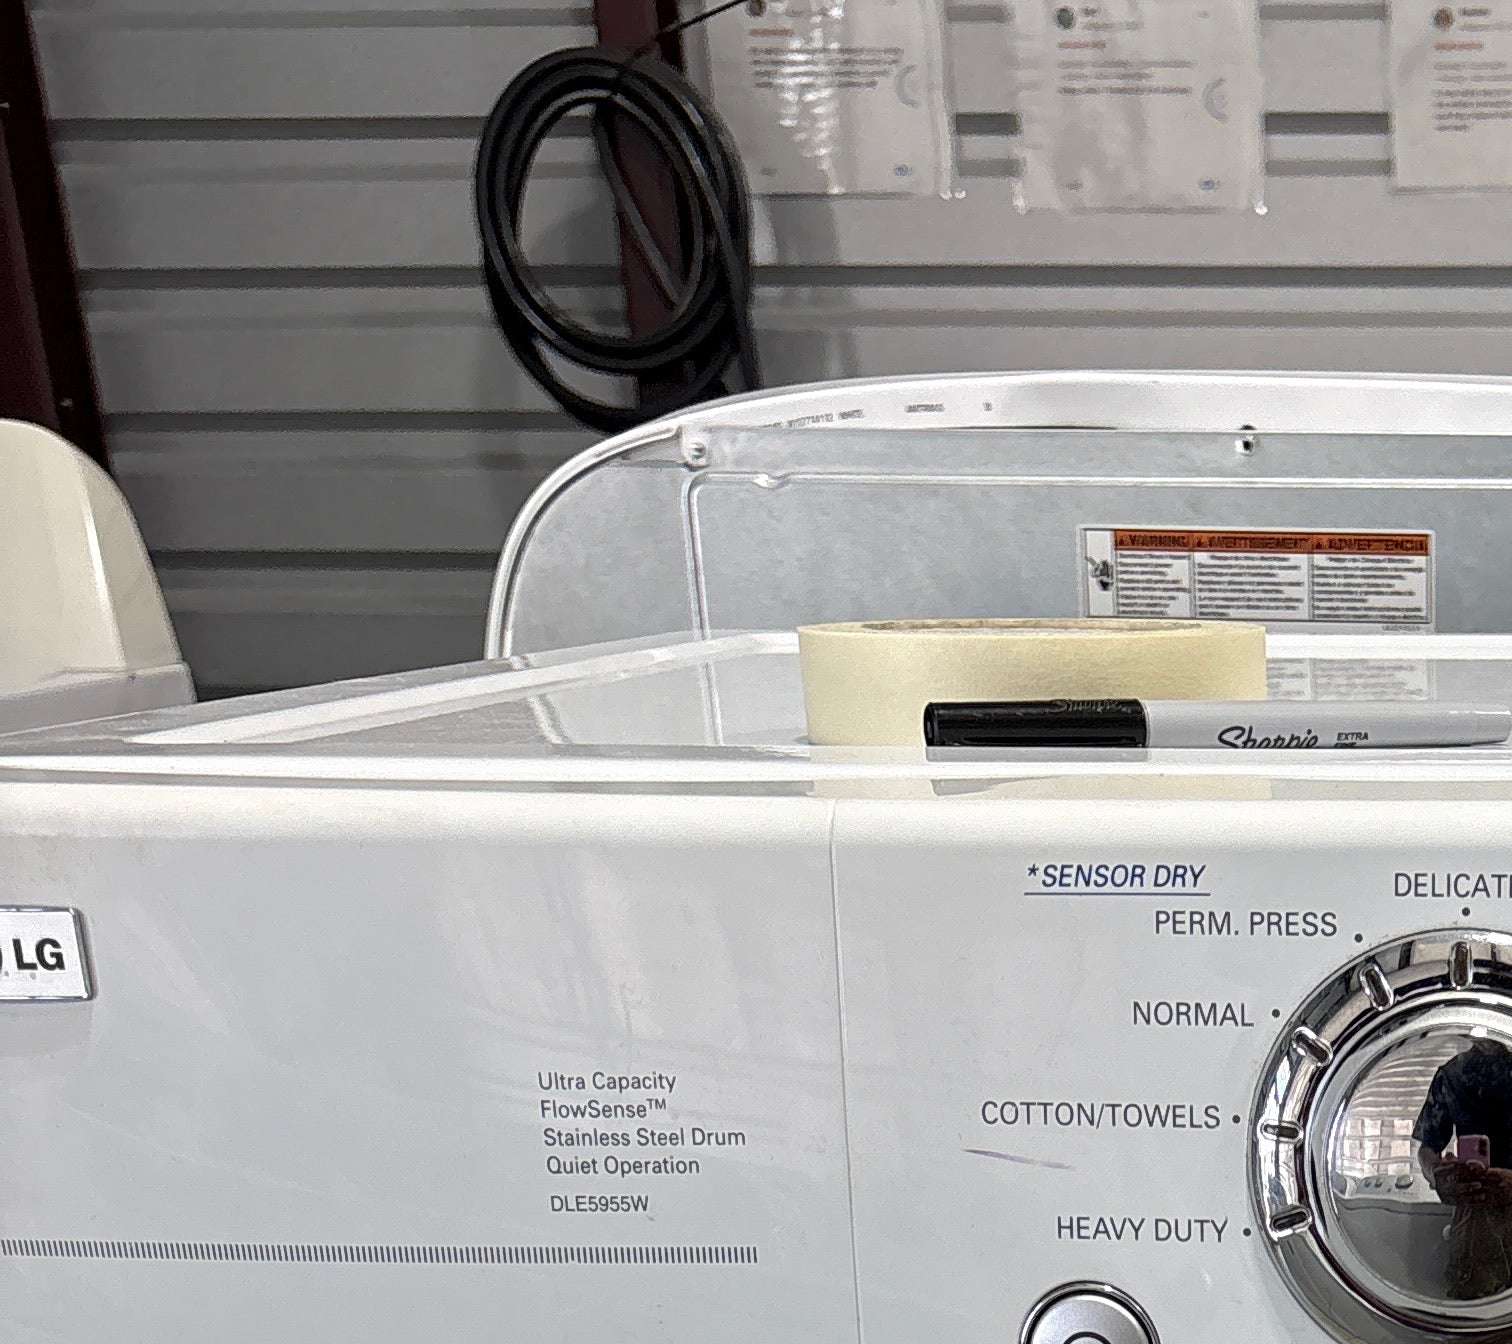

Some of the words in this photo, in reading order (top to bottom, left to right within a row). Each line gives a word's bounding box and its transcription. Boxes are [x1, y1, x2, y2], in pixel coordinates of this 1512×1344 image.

[1336, 732, 1369, 741] EXTRA
[1154, 865, 1206, 888] DRY
[1156, 911, 1239, 935] PERM.
[1250, 912, 1337, 936] PRESS
[12, 938, 65, 971] LG
[1134, 1001, 1254, 1027] NORMAL
[538, 1072, 585, 1090] Ultra
[593, 1072, 676, 1093] Capacity
[982, 1101, 1220, 1129] COTTON/TOWELS
[544, 1128, 630, 1146] Stainless
[637, 1128, 684, 1146] Steel
[692, 1128, 745, 1145] Drum
[547, 1156, 598, 1174] Quiet
[604, 1156, 699, 1178] Operation
[551, 1195, 648, 1212] DLE5955W
[1058, 1216, 1145, 1241] HEAVY
[1155, 1218, 1228, 1242] DUTY
